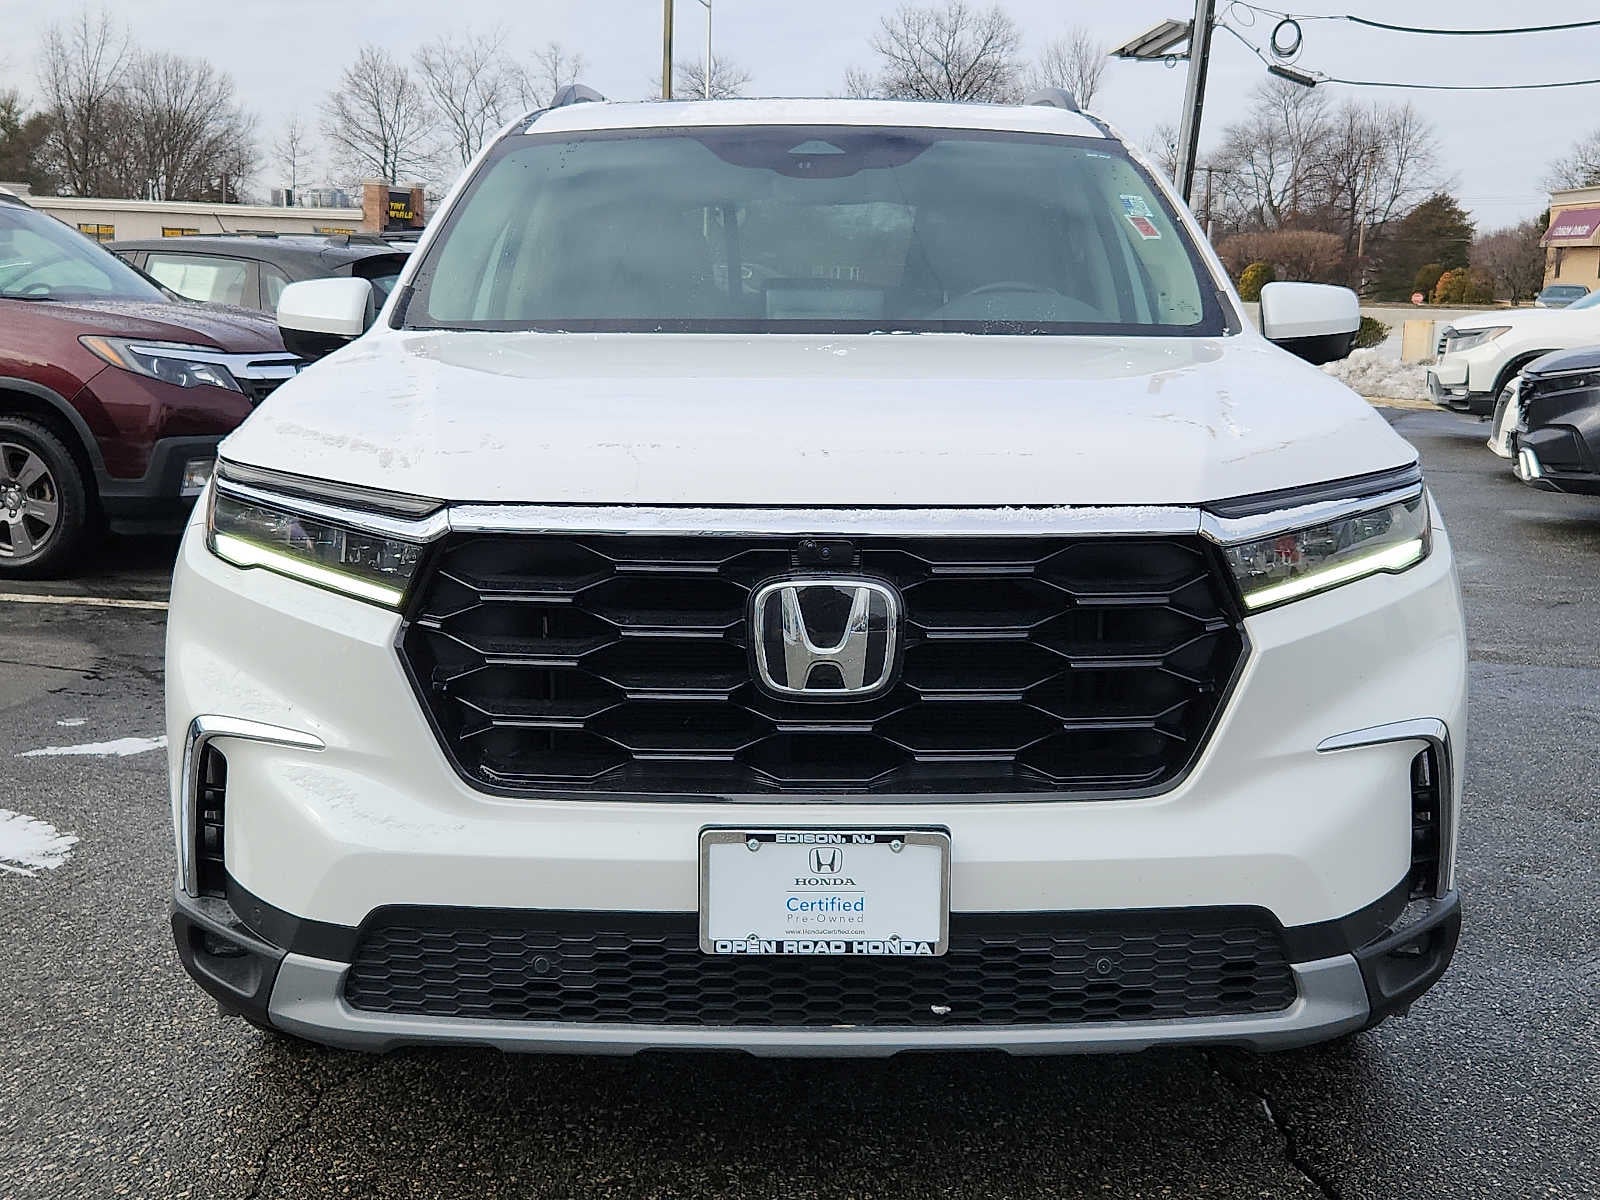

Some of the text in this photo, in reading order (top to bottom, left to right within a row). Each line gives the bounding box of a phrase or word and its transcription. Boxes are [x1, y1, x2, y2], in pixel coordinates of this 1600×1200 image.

[775, 833, 876, 844] EDISON, NJ
[794, 877, 857, 886] HONDA
[786, 897, 865, 912] Certified
[786, 914, 864, 923] Pre-Owned
[714, 940, 933, 955] OPEN ROAD HONDA
